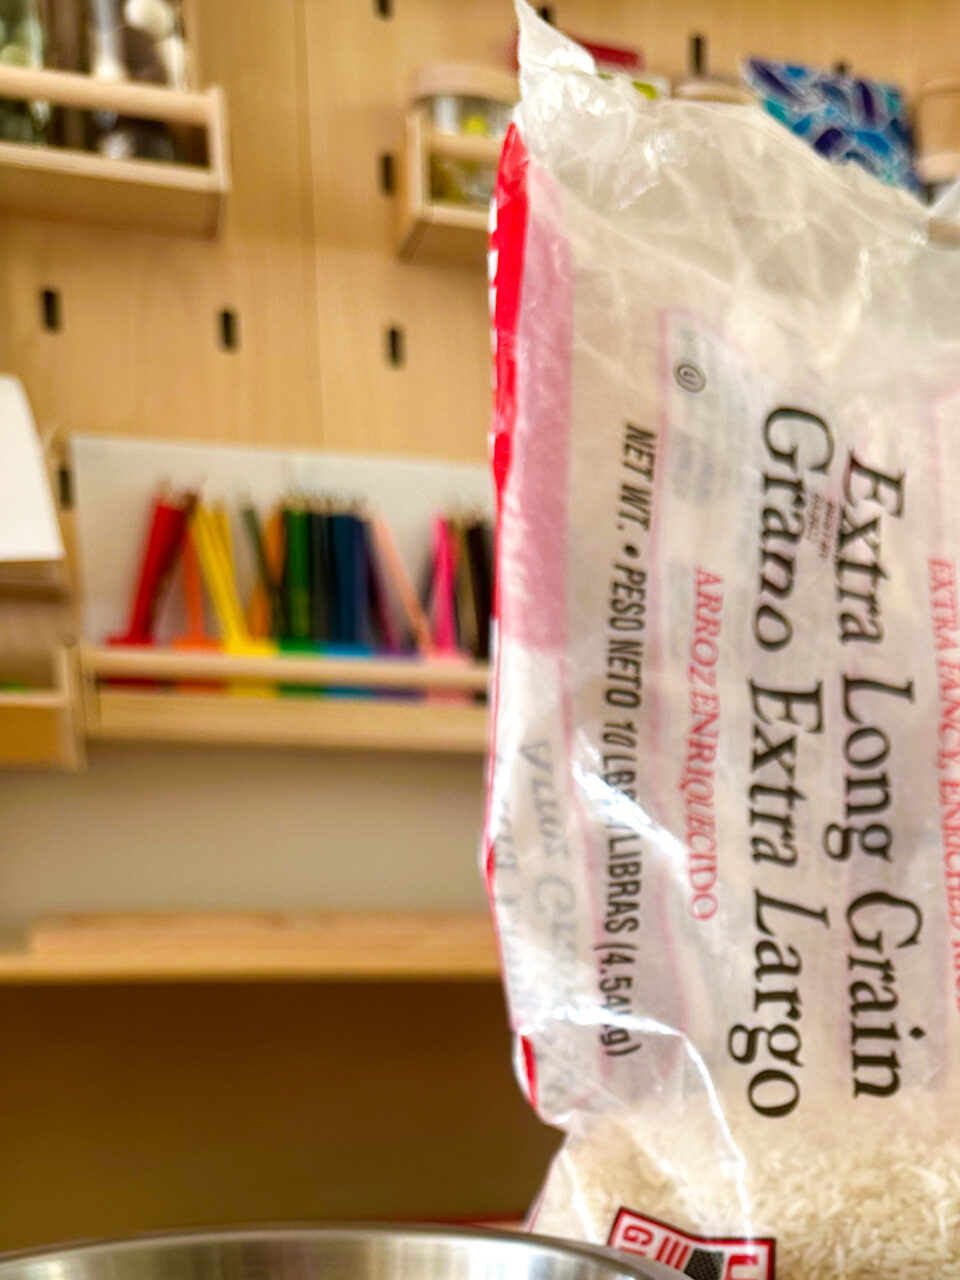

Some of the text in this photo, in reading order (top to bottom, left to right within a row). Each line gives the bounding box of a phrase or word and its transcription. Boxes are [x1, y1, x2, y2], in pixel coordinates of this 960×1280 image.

[622, 424, 657, 482] NET
[617, 483, 653, 532] WT.
[753, 406, 835, 651] Grano
[609, 562, 646, 632] PESO
[928, 558, 960, 650] EXTRA
[605, 640, 642, 710] NETO
[602, 719, 639, 749] 10
[679, 567, 724, 921] ARROZ ENRIQUECIDO
[746, 678, 824, 868] Extra
[822, 448, 927, 1098] Extra Long Grain
[593, 941, 643, 1057] (4.54g)
[728, 887, 832, 1118] Largo
